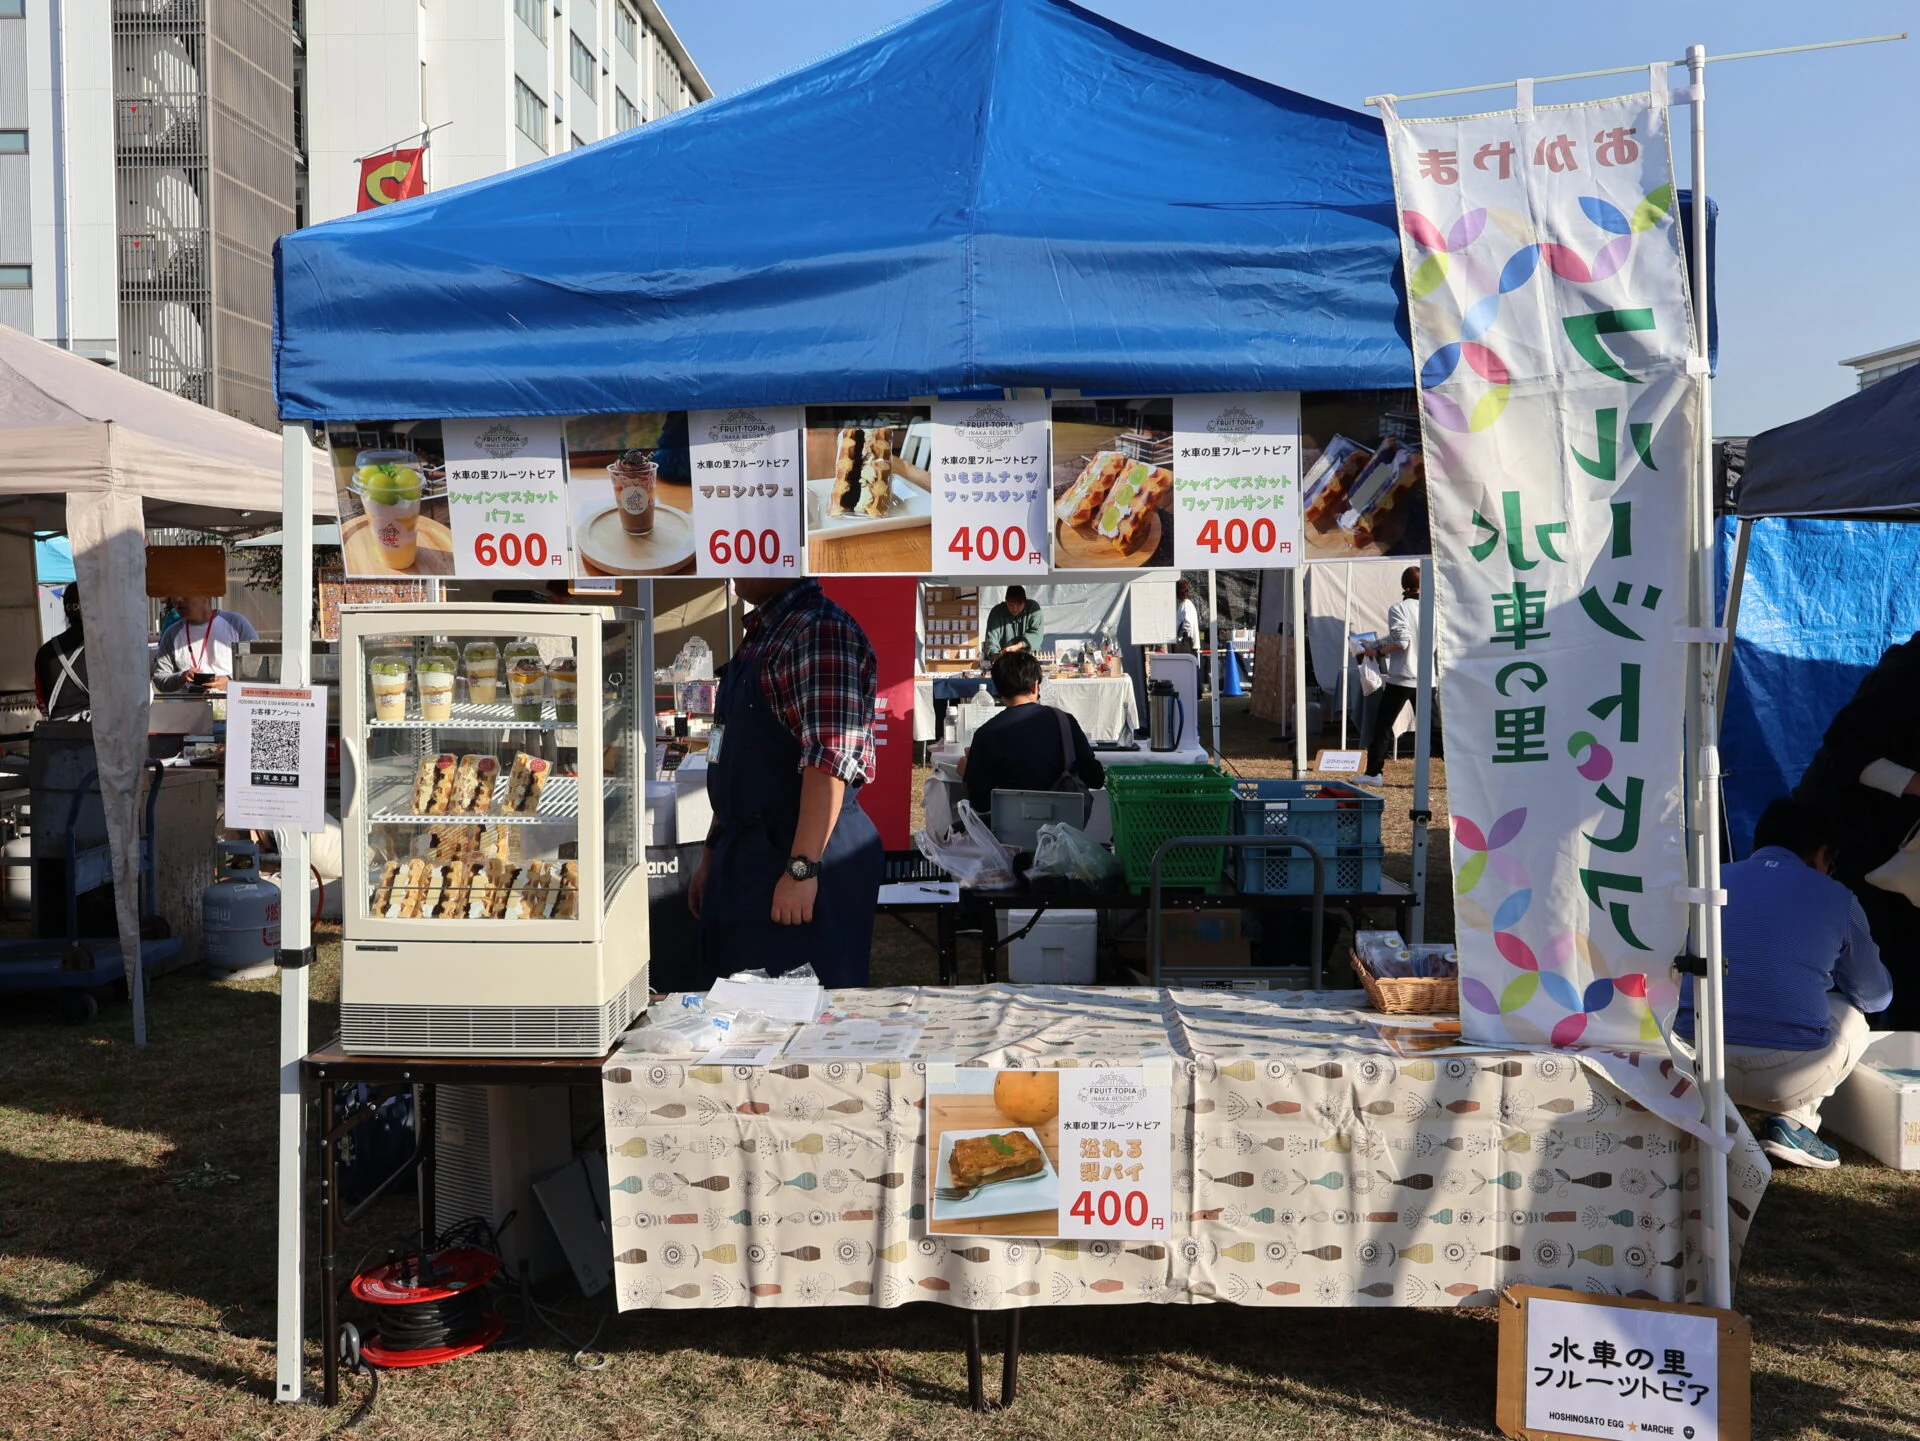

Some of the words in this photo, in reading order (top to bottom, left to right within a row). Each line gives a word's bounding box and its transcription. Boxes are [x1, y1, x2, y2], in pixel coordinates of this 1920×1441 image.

[699, 483, 794, 499] マロンパフェ
[1175, 475, 1292, 491] シャインマスカット
[448, 490, 559, 504] シャインマスカット
[944, 490, 1038, 503] ワッフルサンド
[1182, 494, 1285, 512] ワッフルサンド
[485, 508, 526, 524] パフェ
[251, 708, 301, 717] お客様アンケート
[1080, 1137, 1143, 1159] 溢れる
[1080, 1161, 1145, 1183] 梨パイ
[1549, 1336, 1693, 1379] 水車の里
[1533, 1366, 1709, 1406] フルーツトピア
[1549, 1411, 1606, 1426] HOSHINOSATO
[1607, 1418, 1624, 1430] EGG
[1640, 1423, 1675, 1436] MARCHE
